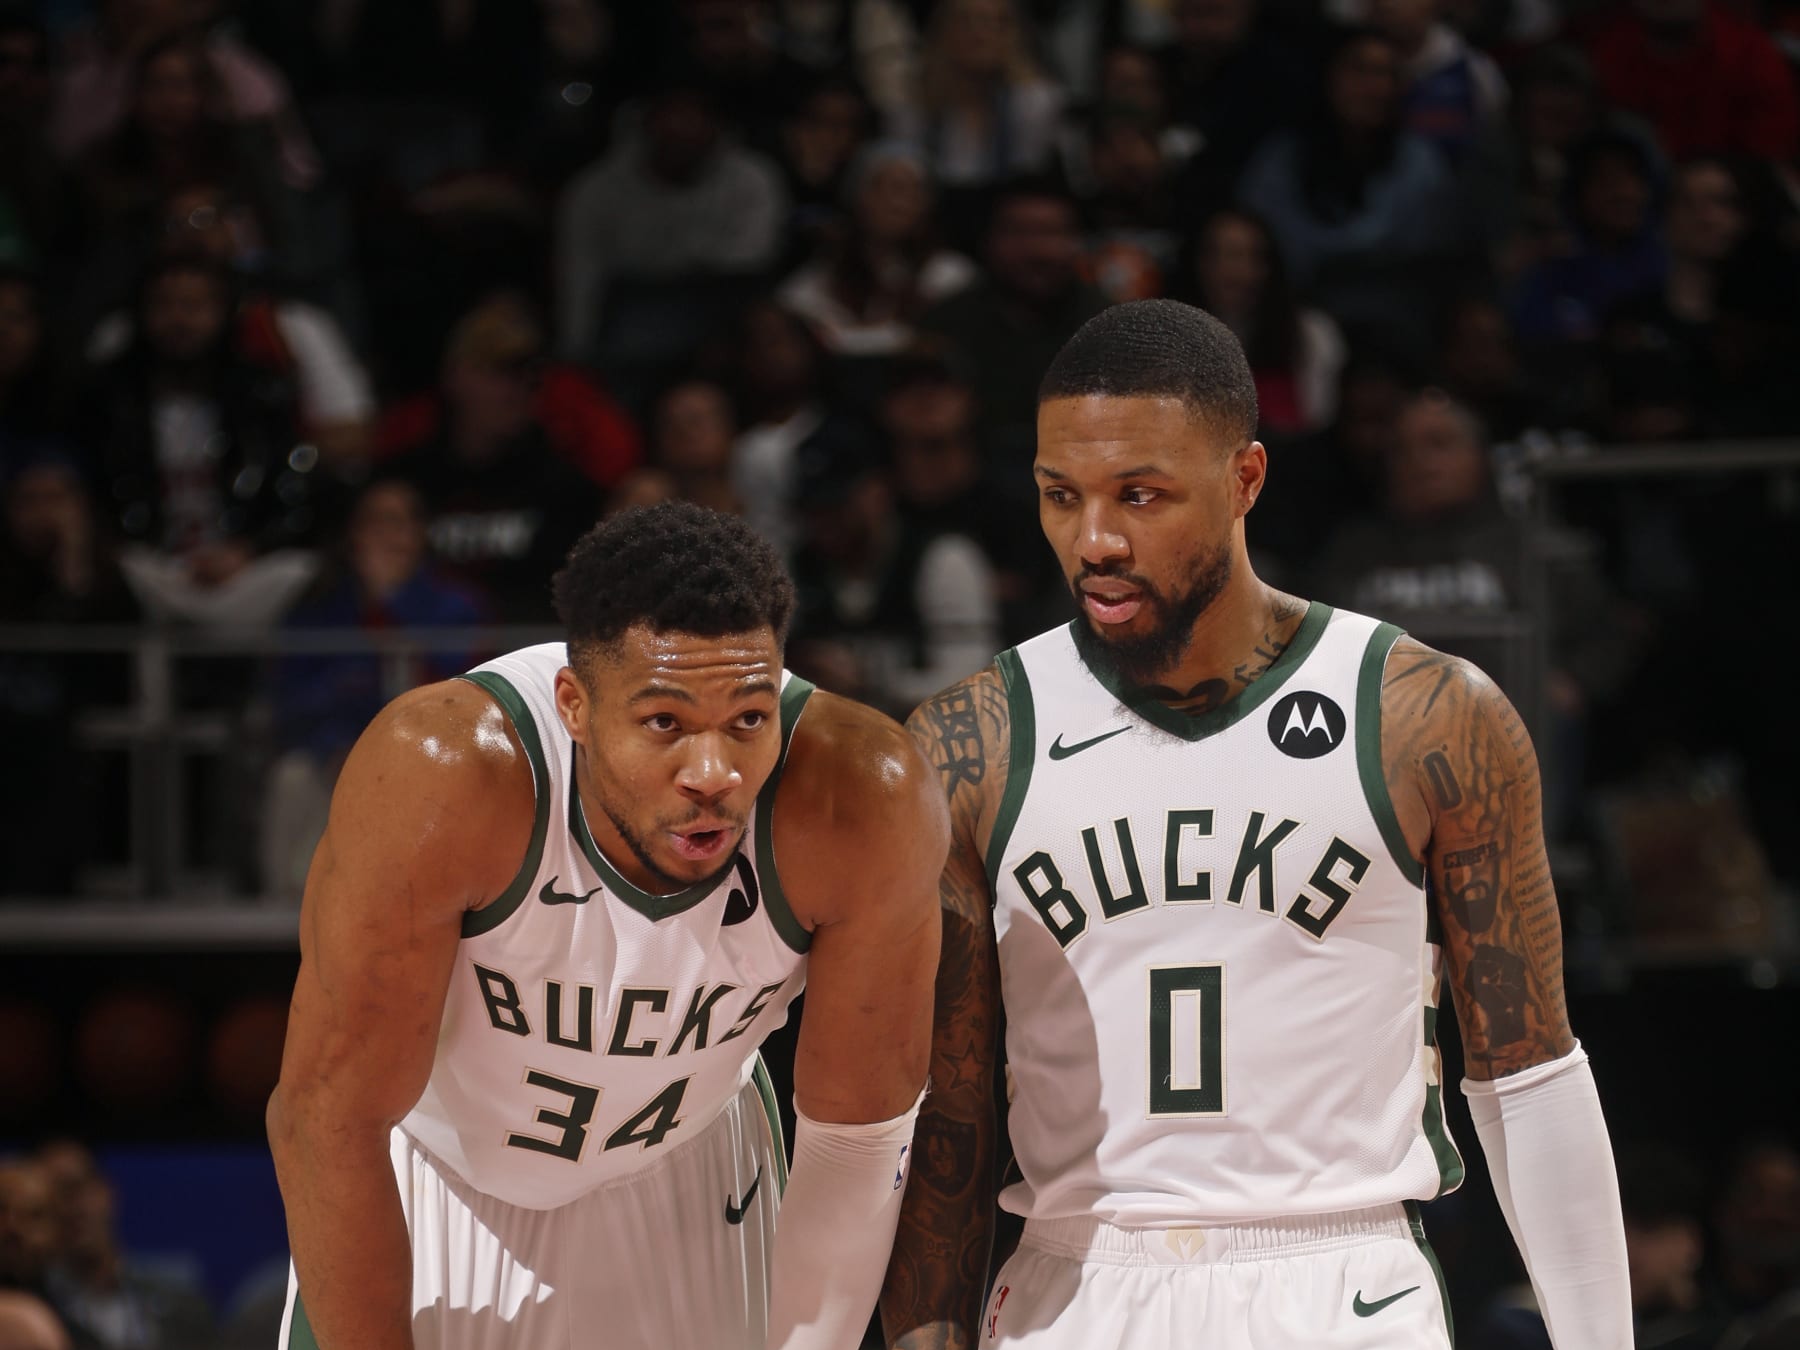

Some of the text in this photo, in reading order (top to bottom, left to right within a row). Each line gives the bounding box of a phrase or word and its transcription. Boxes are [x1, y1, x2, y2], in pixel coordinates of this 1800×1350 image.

[1012, 808, 1372, 951] BUCKS
[469, 960, 789, 1058] BUCKS
[1146, 960, 1228, 1119] 0
[503, 1066, 697, 1165] 34
